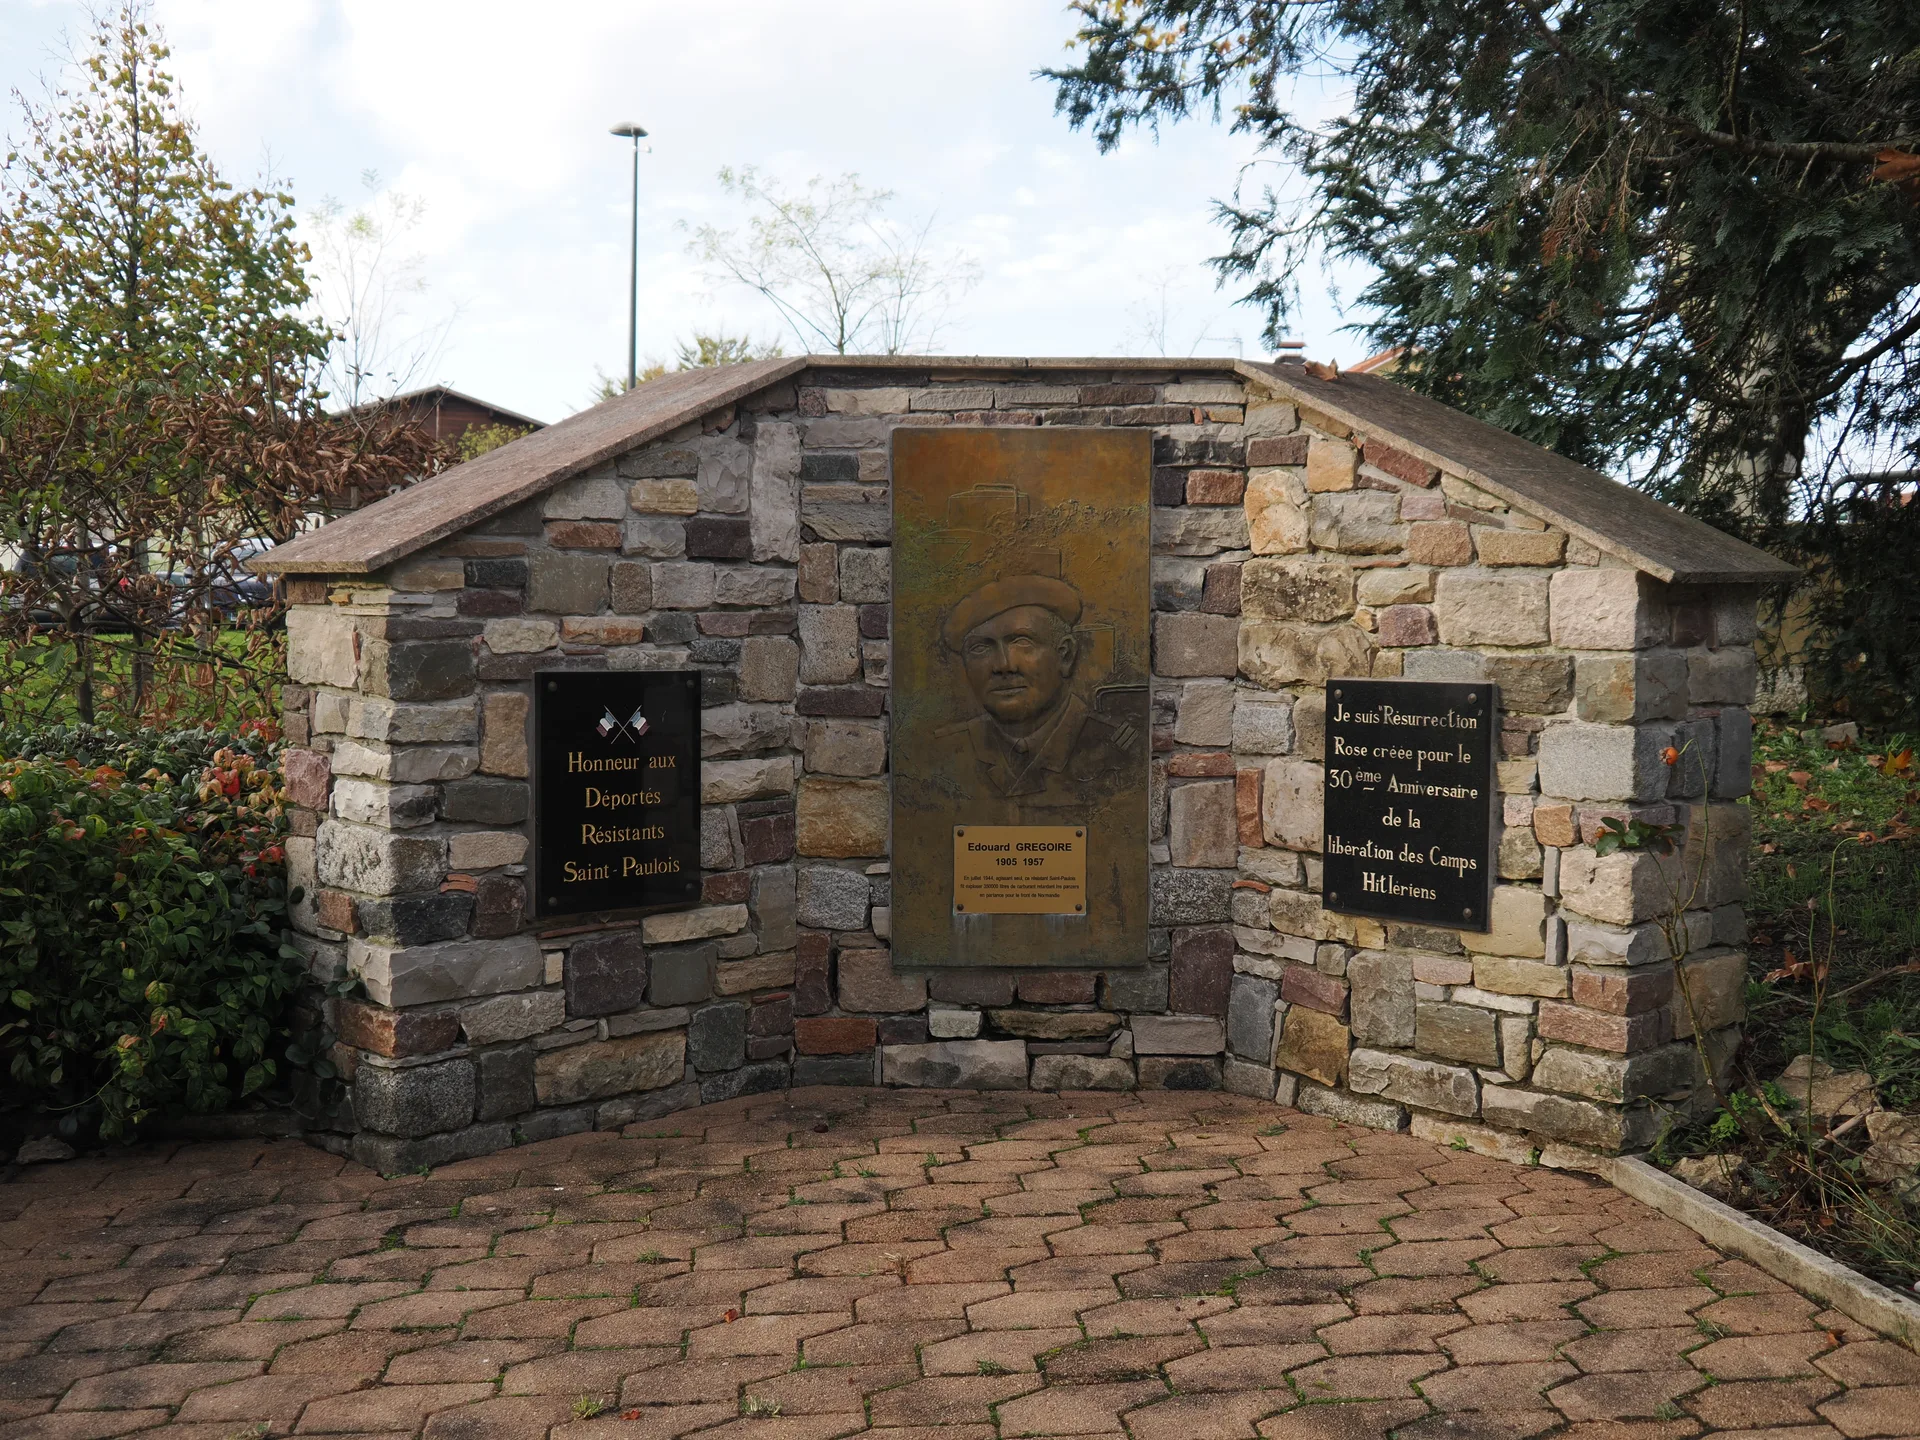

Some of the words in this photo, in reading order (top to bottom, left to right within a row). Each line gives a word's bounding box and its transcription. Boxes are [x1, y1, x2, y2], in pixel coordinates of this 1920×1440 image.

[1334, 703, 1350, 722] Je
[568, 751, 639, 772] Honneur
[649, 755, 676, 769] aux
[1334, 736, 1367, 756] Rose
[1418, 750, 1453, 770] pour
[1458, 744, 1471, 763] le
[1387, 774, 1478, 799] Anniversaire
[585, 787, 660, 810] Déportés
[1382, 807, 1401, 827] de
[1409, 809, 1421, 828] la
[581, 823, 664, 845] Résistants
[968, 843, 1010, 852] Edouard
[1016, 843, 1072, 852] GREGOIRE
[996, 858, 1017, 866] 1905
[1023, 858, 1044, 866] 1957
[1399, 844, 1423, 863] des
[1430, 846, 1477, 877] Camps
[1363, 872, 1436, 900] Hitlériens
